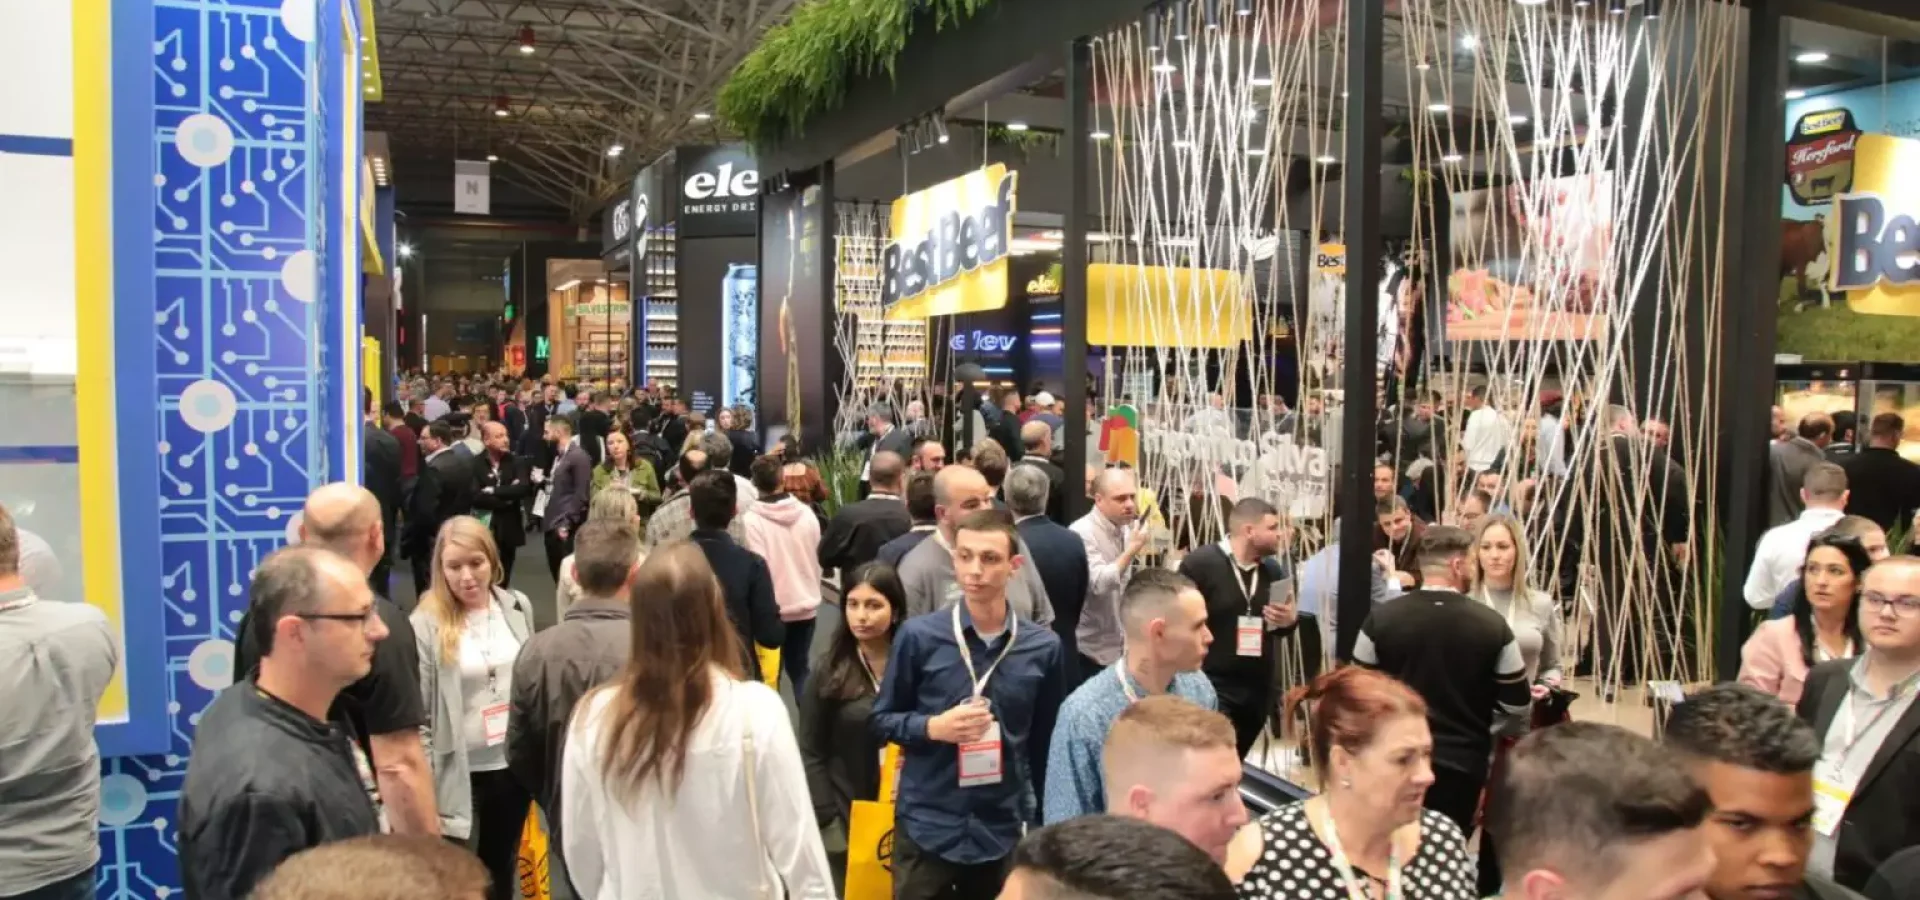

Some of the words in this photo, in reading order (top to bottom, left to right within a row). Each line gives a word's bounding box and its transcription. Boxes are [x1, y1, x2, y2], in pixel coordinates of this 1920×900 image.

[465, 180, 479, 196] N
[684, 203, 728, 215] ENERGY
[1837, 197, 1920, 286] Be
